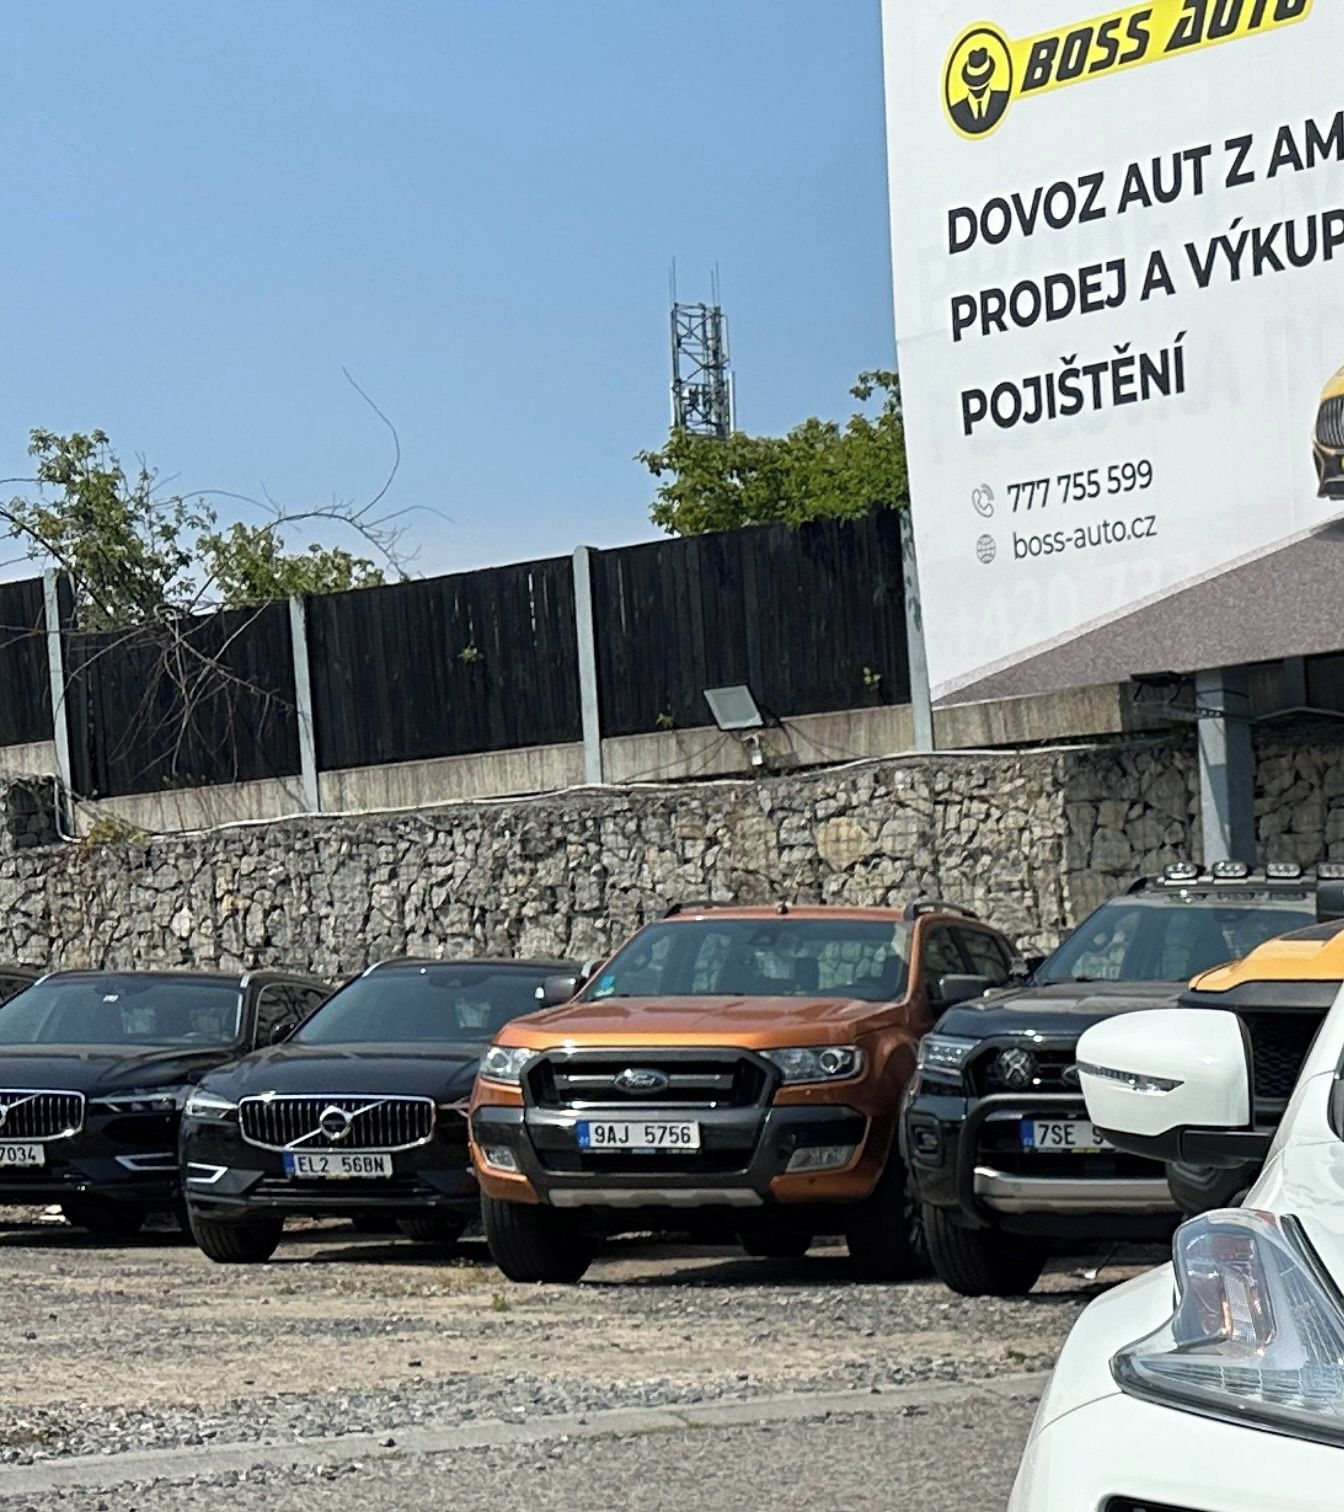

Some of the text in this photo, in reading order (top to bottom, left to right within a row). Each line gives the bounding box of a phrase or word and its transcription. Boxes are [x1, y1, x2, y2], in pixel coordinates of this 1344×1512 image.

[1020, 9, 1153, 93] BOSS
[947, 171, 1107, 255] DOVOZ
[1117, 144, 1212, 214] AUT
[1225, 133, 1255, 188] Z
[951, 257, 1127, 343] PRODEJ
[1140, 249, 1177, 301] A
[961, 330, 1187, 436] POJIŠTĚNÍ
[1006, 459, 1153, 513] 777 755 599
[1012, 514, 1158, 560] boss-auto.cz
[594, 1125, 629, 1144] 9AJ
[644, 1125, 692, 1145] 5756
[1038, 1123, 1076, 1145] 7SE
[297, 1156, 330, 1174] EL2
